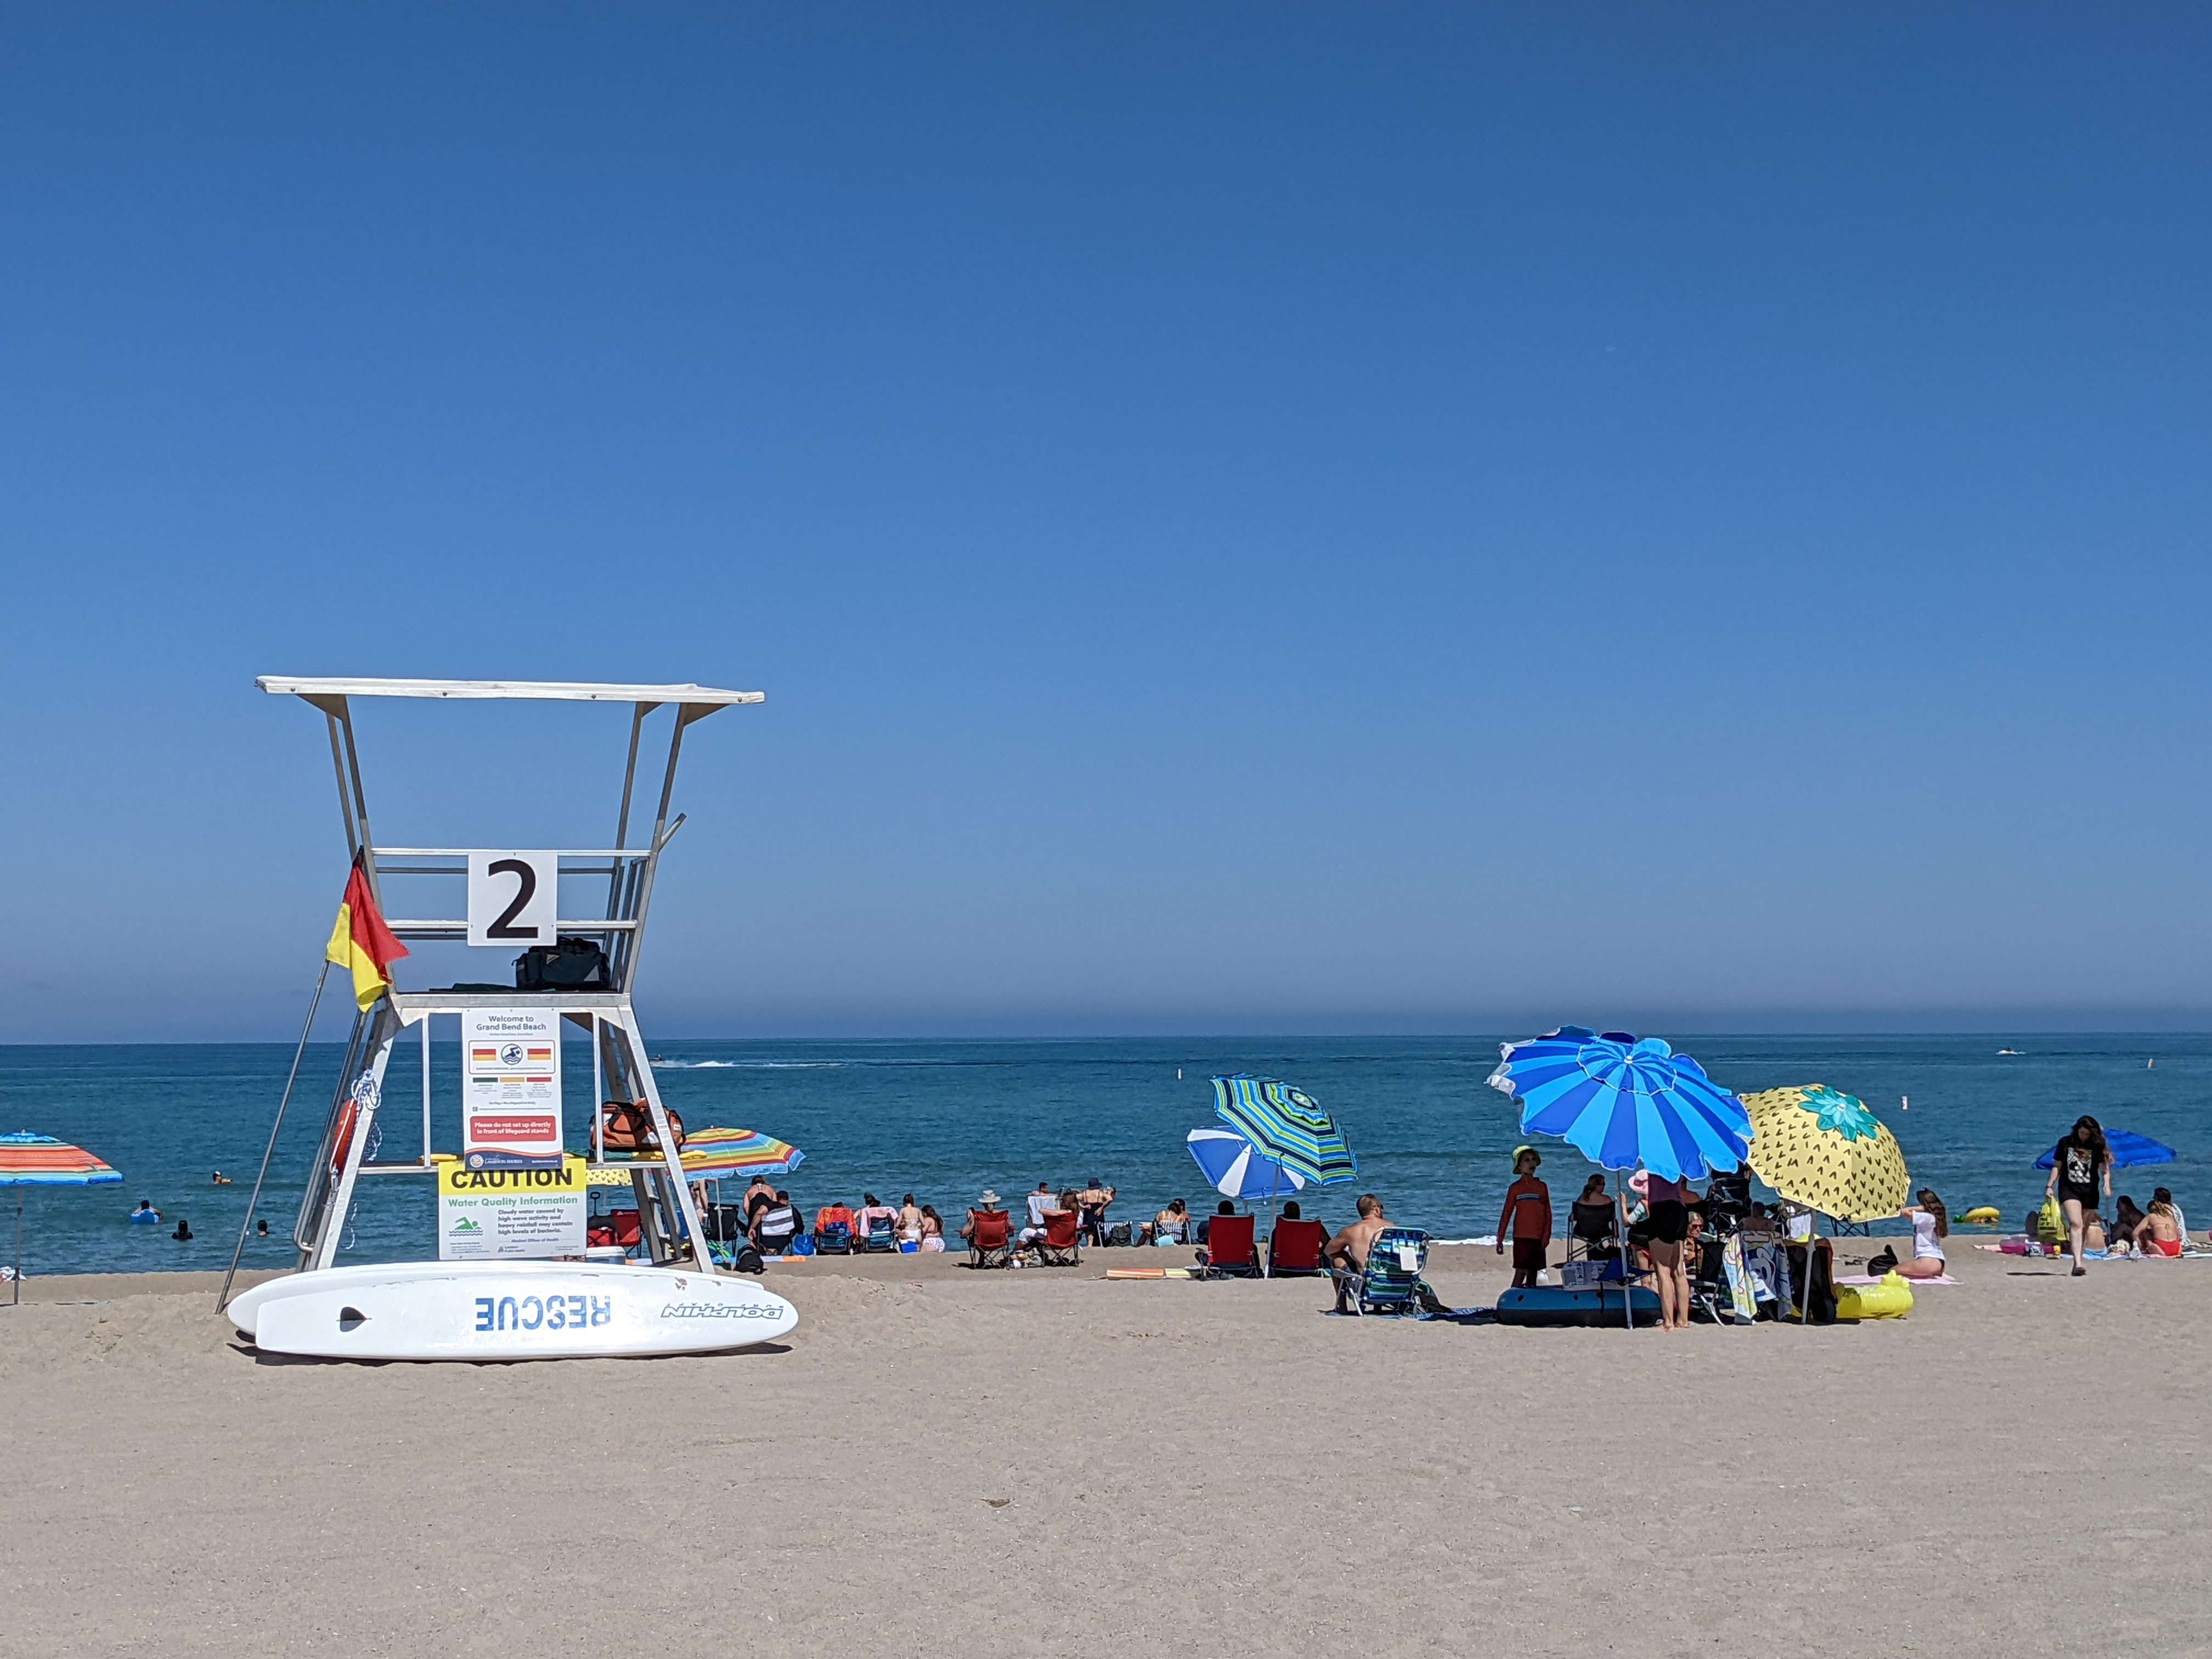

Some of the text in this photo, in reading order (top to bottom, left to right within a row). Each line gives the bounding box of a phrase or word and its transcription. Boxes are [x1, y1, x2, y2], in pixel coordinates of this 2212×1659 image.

[487, 859, 539, 939] 2
[451, 1169, 572, 1188] CAUTION
[448, 1195, 578, 1207] Water Quality Information
[476, 1295, 611, 1331] RESCUE
[661, 1306, 784, 1320] DOLPHIN
